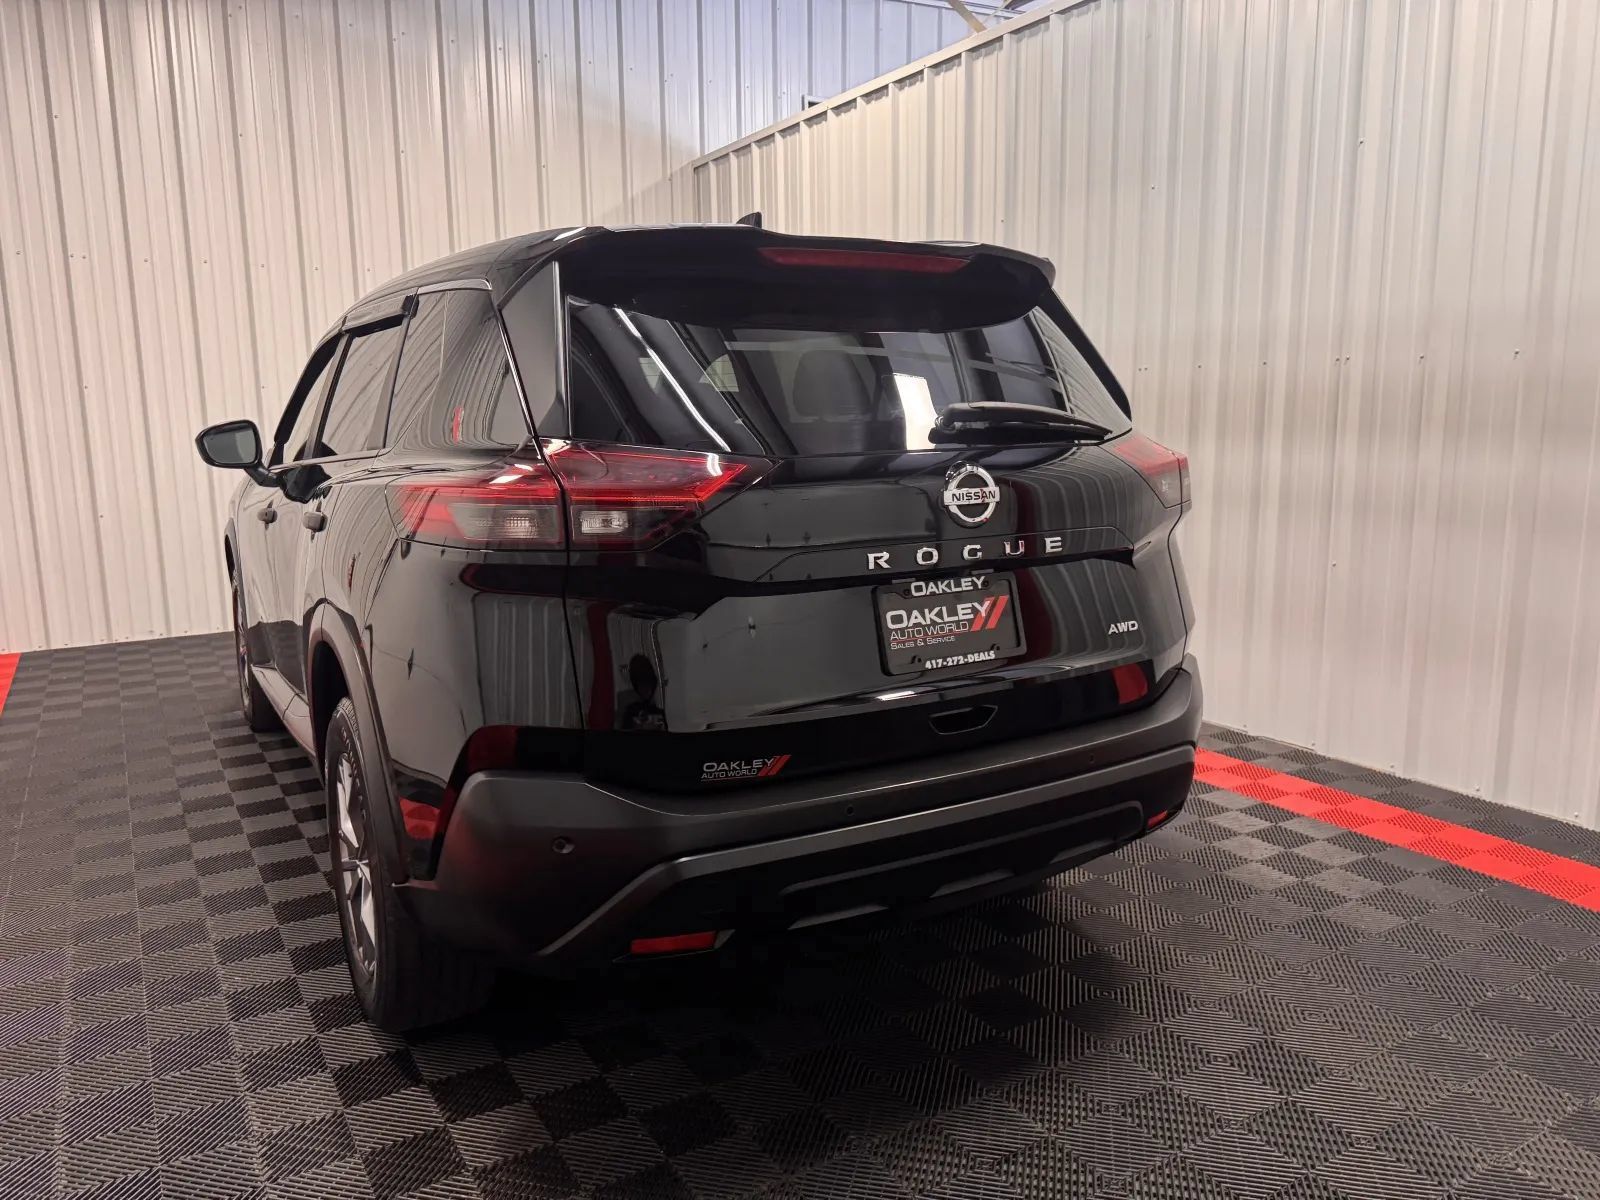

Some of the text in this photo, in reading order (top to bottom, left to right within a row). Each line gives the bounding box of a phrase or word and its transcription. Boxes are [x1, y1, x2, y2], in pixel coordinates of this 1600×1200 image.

[952, 490, 996, 502] NISSAN
[867, 536, 1063, 570] ROGUE
[910, 575, 986, 597] OAKLEY
[885, 600, 991, 630] OAKLEY
[890, 621, 969, 641] AUTO WORLD
[1107, 620, 1140, 636] AWD
[916, 638, 925, 647] &
[925, 650, 996, 670] 417-272-DEALS
[701, 768, 757, 780] AUTO WORLD
[703, 758, 774, 772] OAKLEY
